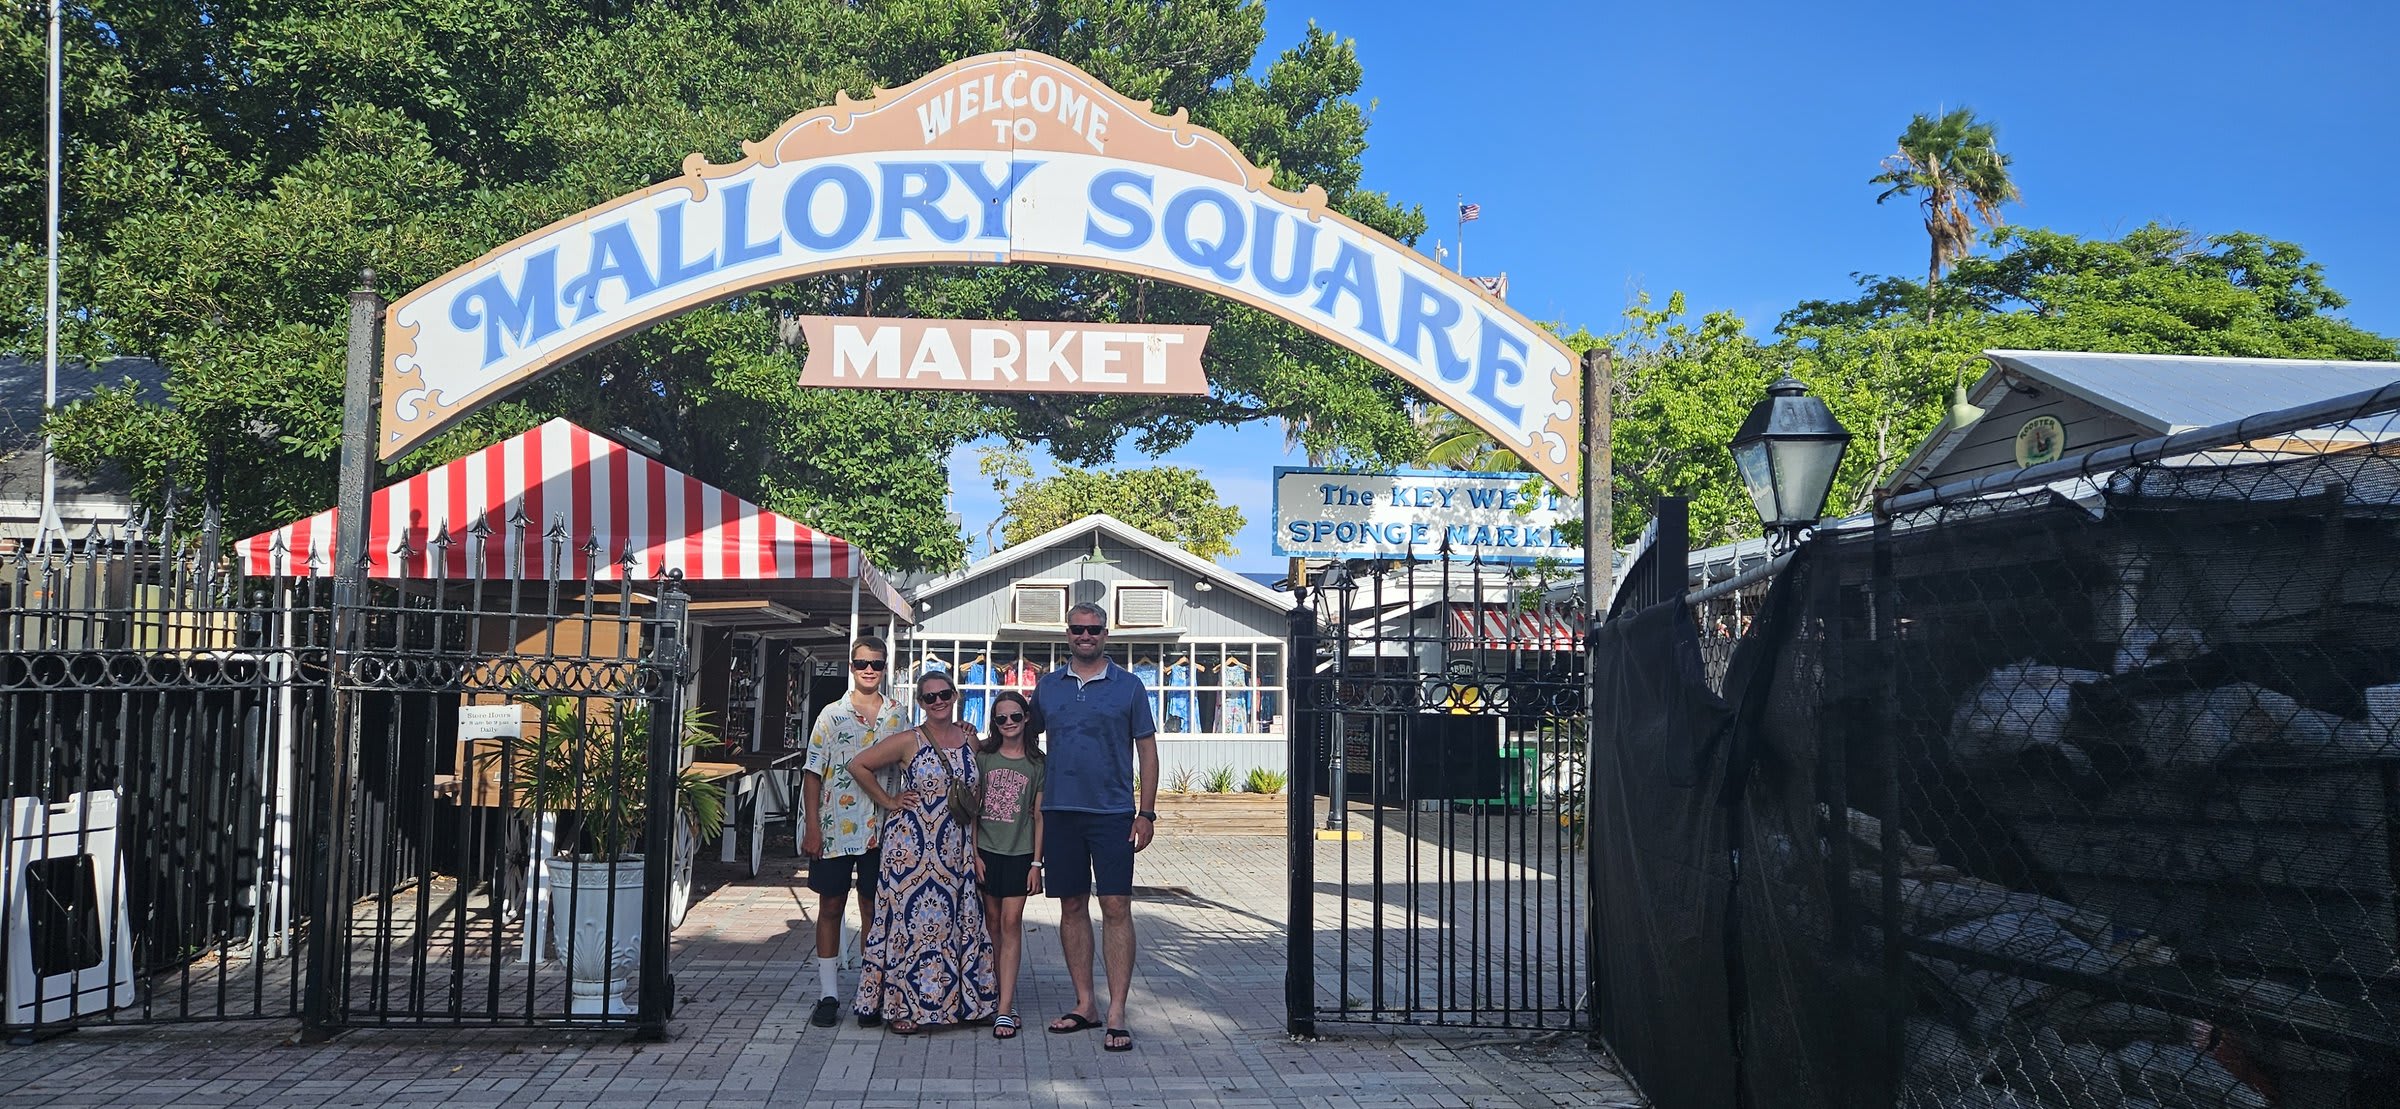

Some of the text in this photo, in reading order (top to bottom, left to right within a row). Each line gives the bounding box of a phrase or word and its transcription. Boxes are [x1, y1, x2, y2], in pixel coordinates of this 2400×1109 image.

[917, 69, 1109, 155] WELCOME
[991, 117, 1037, 144] TO
[448, 160, 1530, 428] MALLORY SQUARE
[832, 324, 1185, 385] MARKET
[2020, 419, 2055, 440] ROOSTER
[1319, 482, 1375, 507] The
[1390, 484, 1459, 510] KEY
[1288, 519, 1573, 548] SPONGE MARKE
[480, 726, 497, 734] Daily
